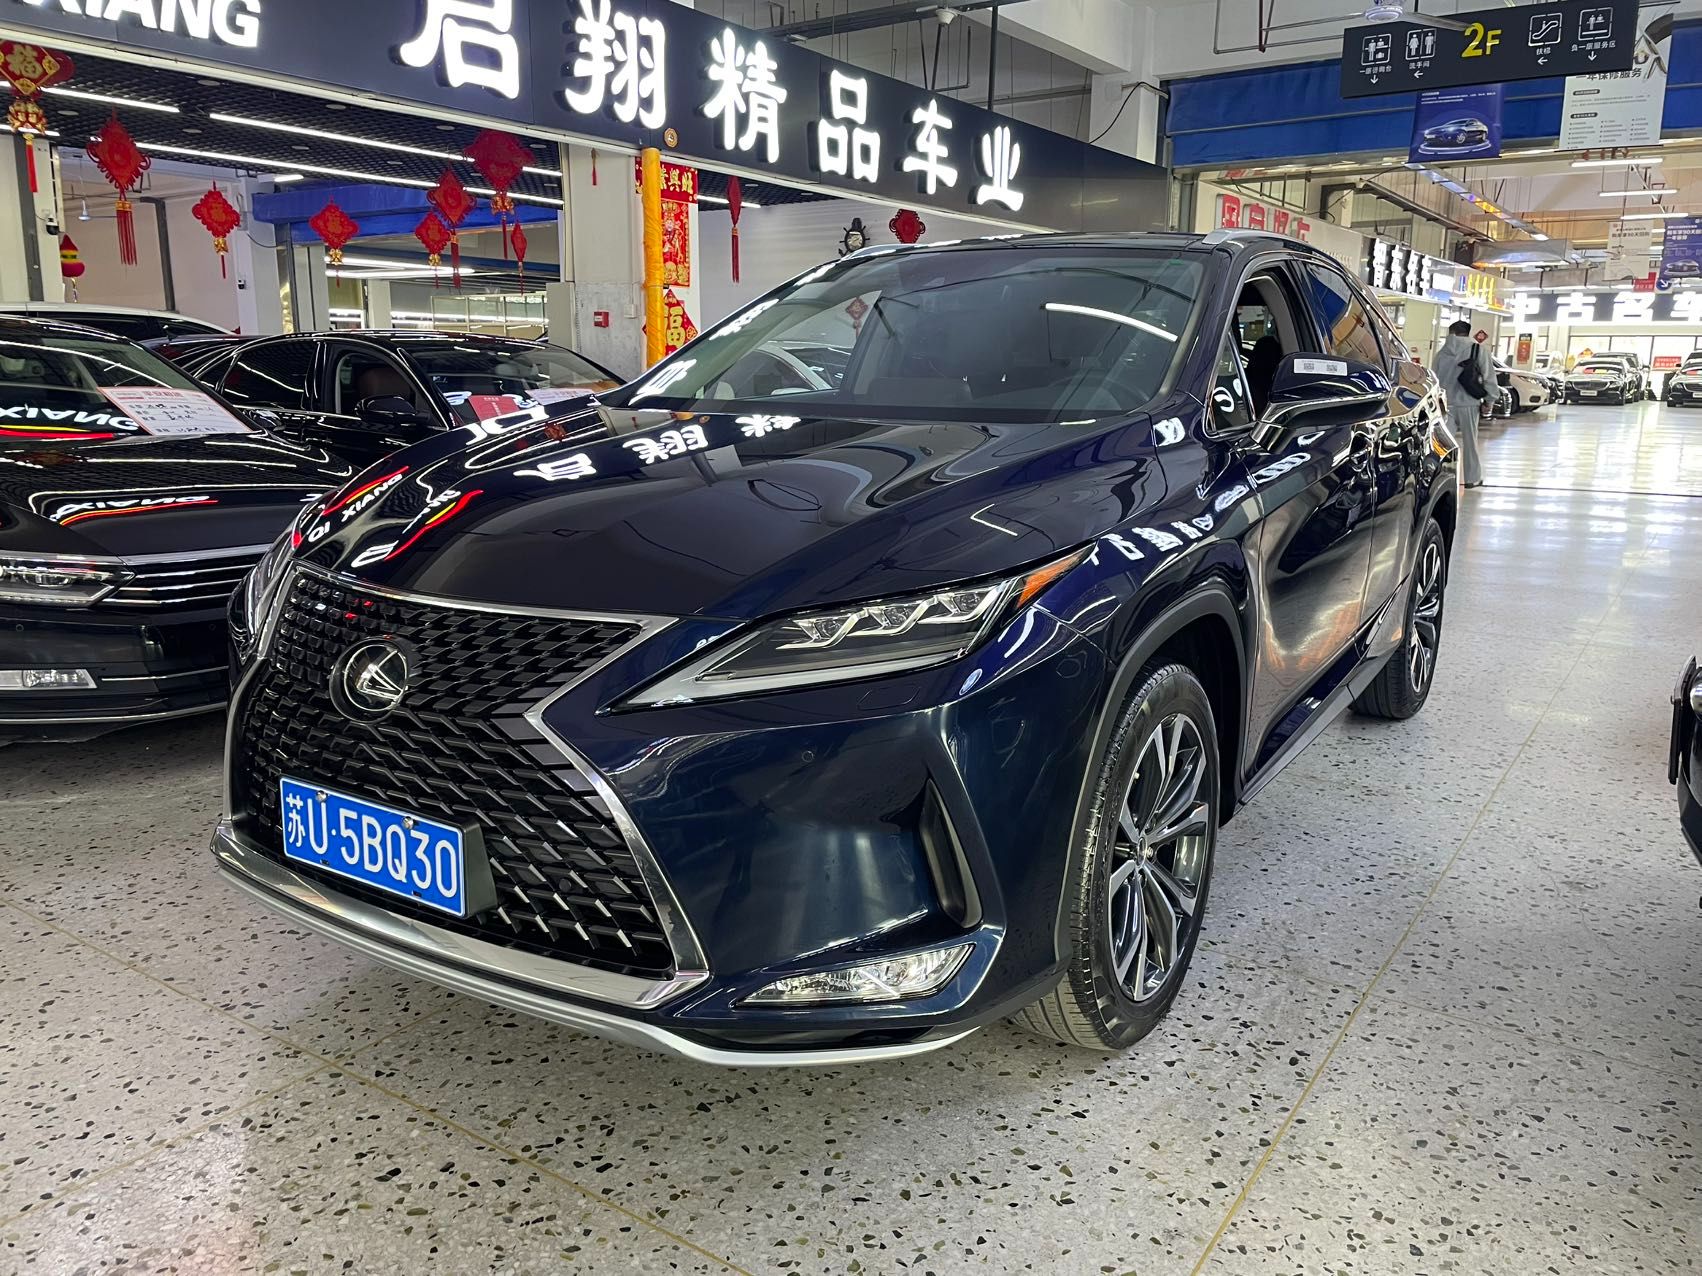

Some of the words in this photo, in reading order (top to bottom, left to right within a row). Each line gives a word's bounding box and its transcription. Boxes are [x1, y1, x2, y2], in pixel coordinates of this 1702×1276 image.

[24, 0, 261, 48] ANG
[1461, 22, 1502, 58] 2F
[400, 0, 1025, 212] 启翔精品车业
